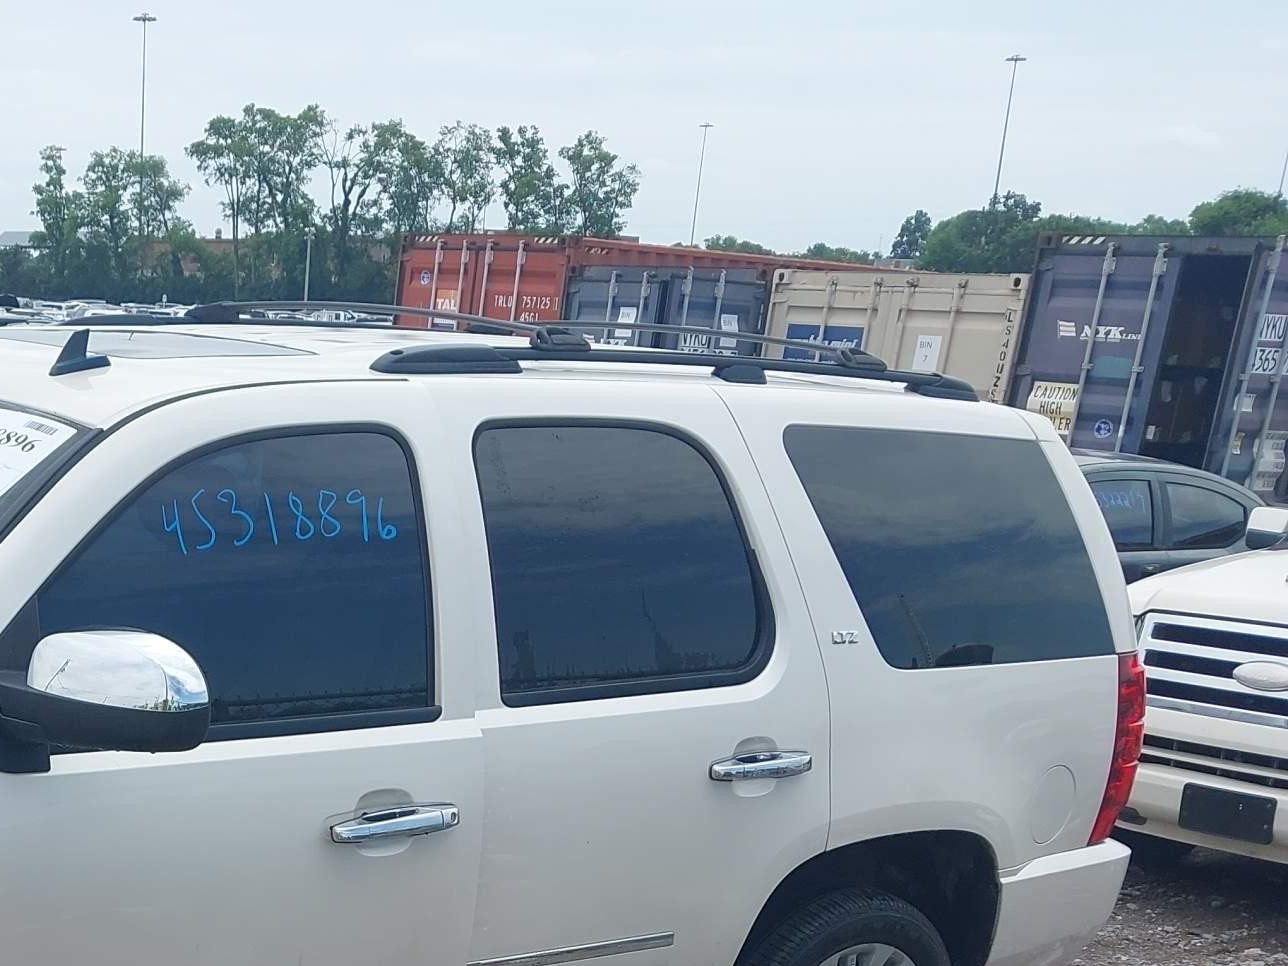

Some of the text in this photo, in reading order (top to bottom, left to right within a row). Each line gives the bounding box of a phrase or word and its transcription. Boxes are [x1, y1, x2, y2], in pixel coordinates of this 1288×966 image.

[522, 295, 552, 310] 757125
[1080, 324, 1125, 342] NYK
[919, 339, 934, 350] BIN
[1033, 384, 1080, 400] CAUTION
[1039, 400, 1063, 415] HIGH
[161, 488, 398, 555] 45318896
